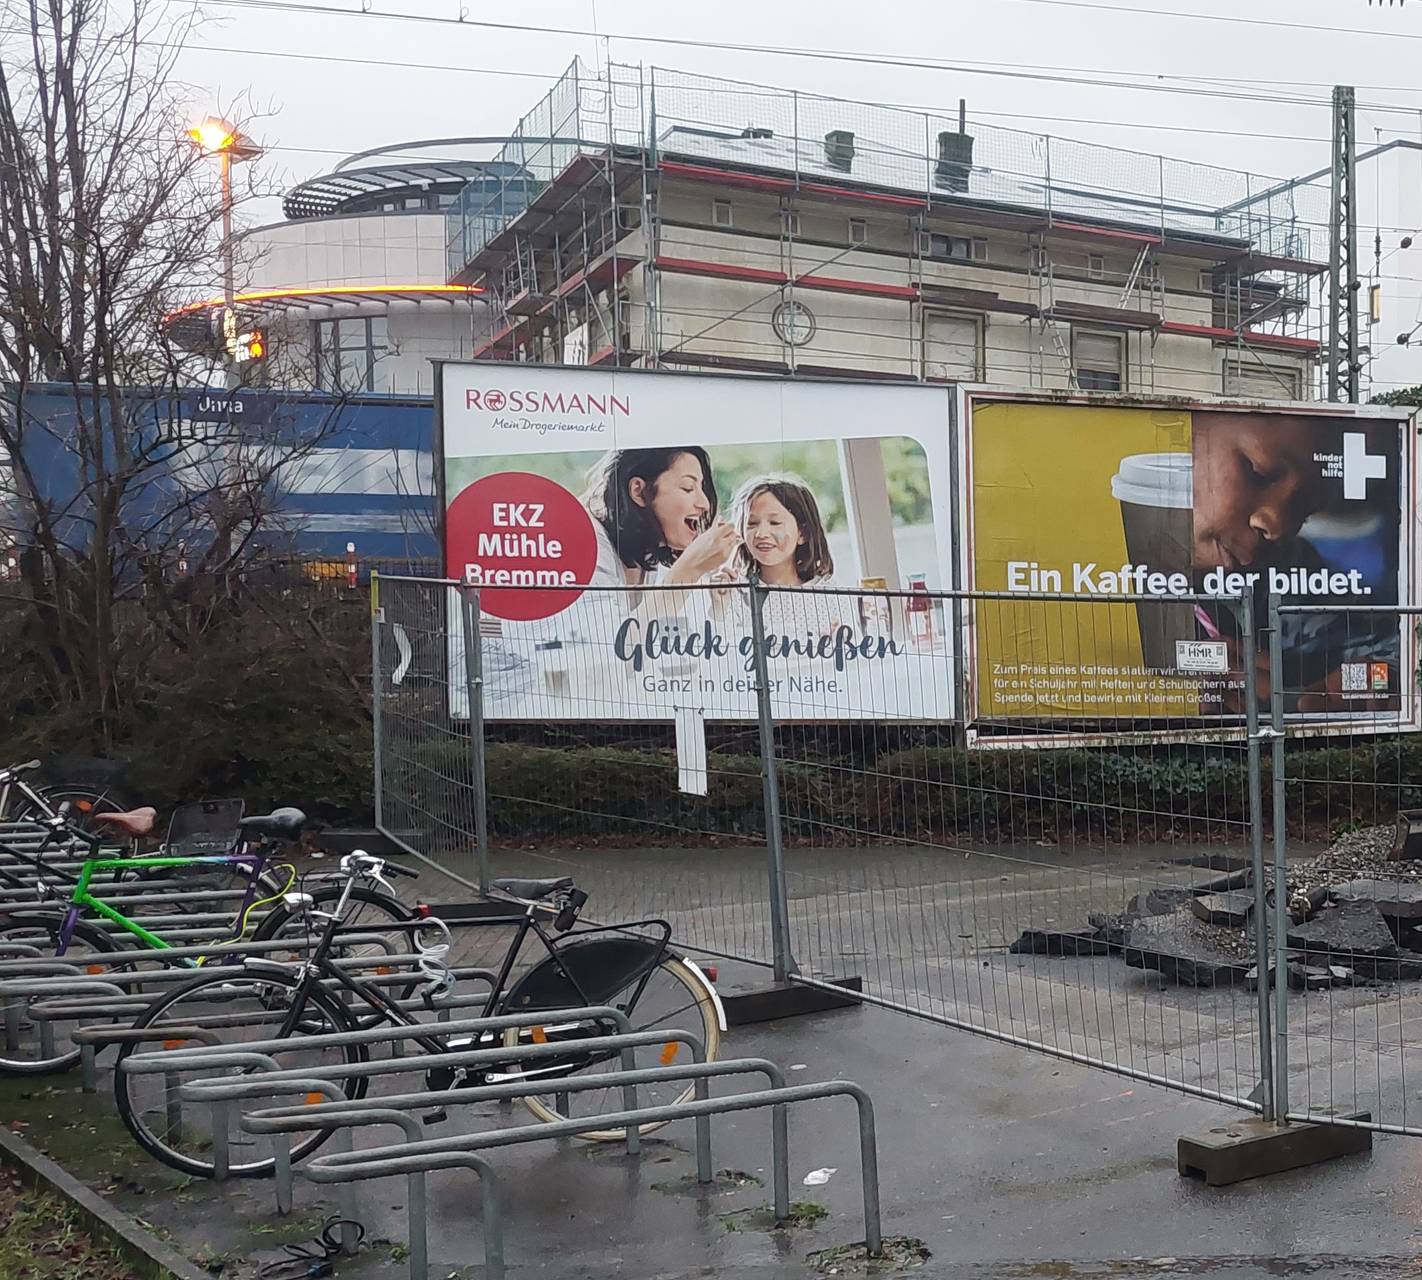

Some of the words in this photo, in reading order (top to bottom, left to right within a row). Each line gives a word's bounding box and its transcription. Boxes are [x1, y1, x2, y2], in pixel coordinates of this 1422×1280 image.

[465, 388, 630, 417] ROSSMANN
[491, 417, 519, 431] Mein
[519, 418, 605, 436] Drogeriemarkt
[1313, 453, 1343, 462] kinder
[1327, 461, 1343, 469] not
[1321, 468, 1343, 478] hilfe
[492, 503, 545, 528] EKZ
[477, 533, 563, 559] Mühle
[464, 564, 577, 586] Bremme
[1007, 561, 1061, 592] Ein
[1203, 566, 1260, 595] der
[1269, 567, 1371, 596] bildet.
[613, 618, 729, 672] Glück
[738, 625, 904, 672] genießen
[993, 664, 1018, 675] Zum
[1049, 665, 1077, 675] eines
[1160, 665, 1175, 676] wir
[643, 675, 691, 694] Ganz
[698, 674, 715, 693] in
[789, 675, 843, 694] Nähe.
[993, 678, 1009, 689] für
[1100, 679, 1134, 690] Heften
[994, 692, 1034, 704] Spende
[1125, 692, 1142, 703] mit
